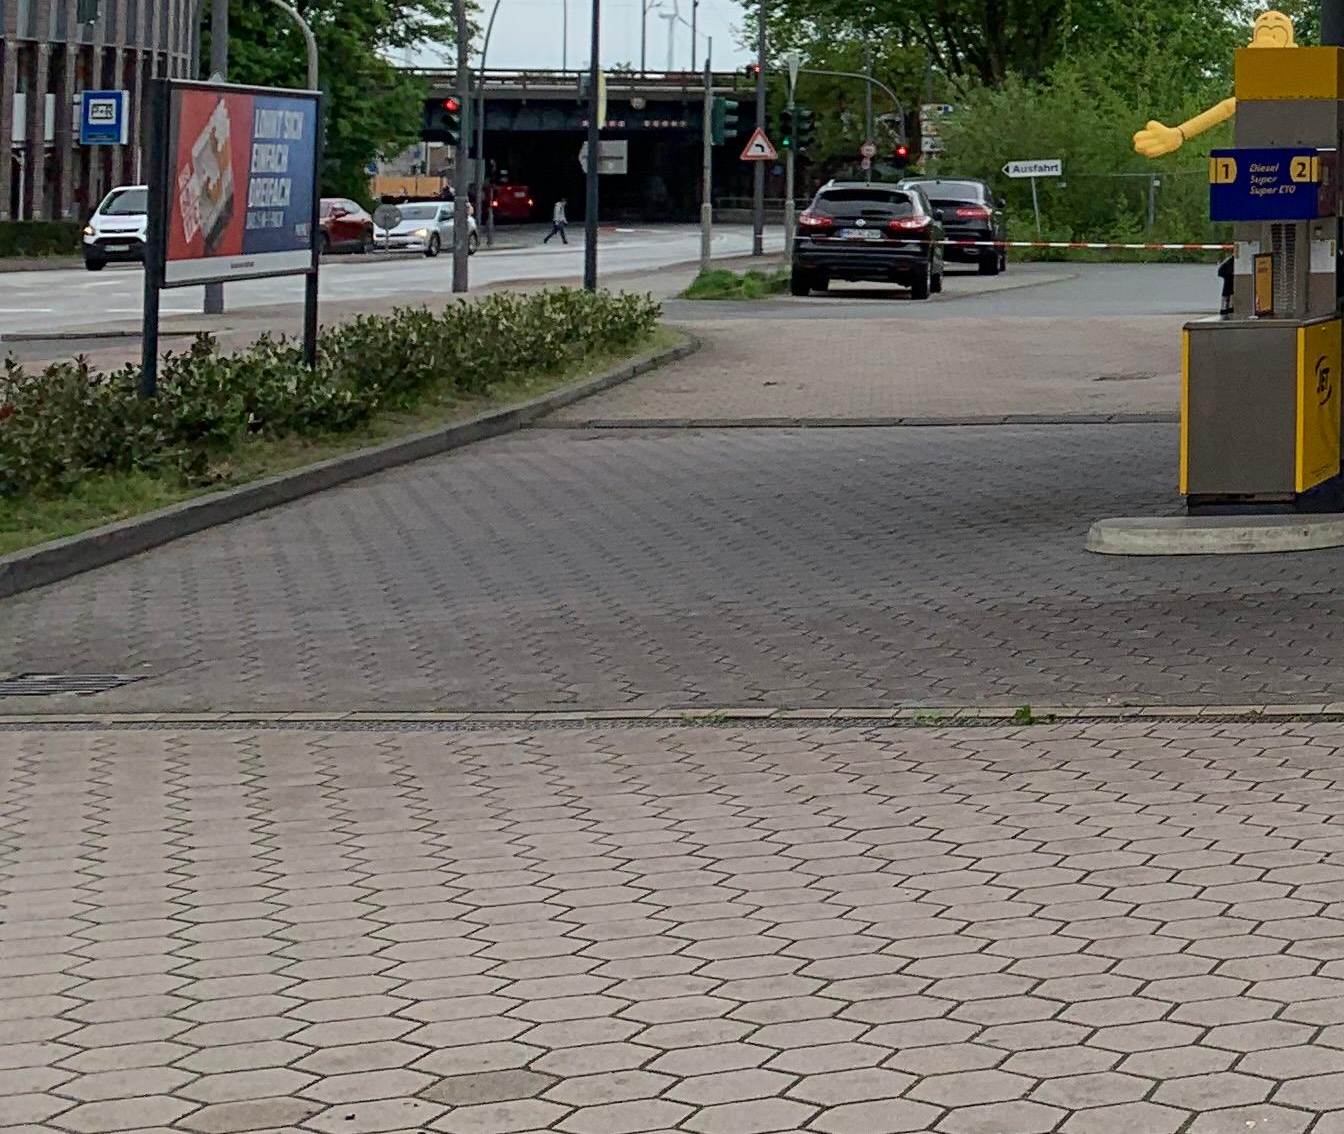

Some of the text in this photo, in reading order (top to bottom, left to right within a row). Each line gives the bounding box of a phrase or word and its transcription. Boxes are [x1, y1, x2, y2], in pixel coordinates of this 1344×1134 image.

[1012, 164, 1059, 173] Ausfahrt
[1249, 163, 1280, 173] Diesel
[1296, 162, 1306, 178] 2
[1249, 175, 1278, 185] Super
[1249, 185, 1297, 197] Super E10
